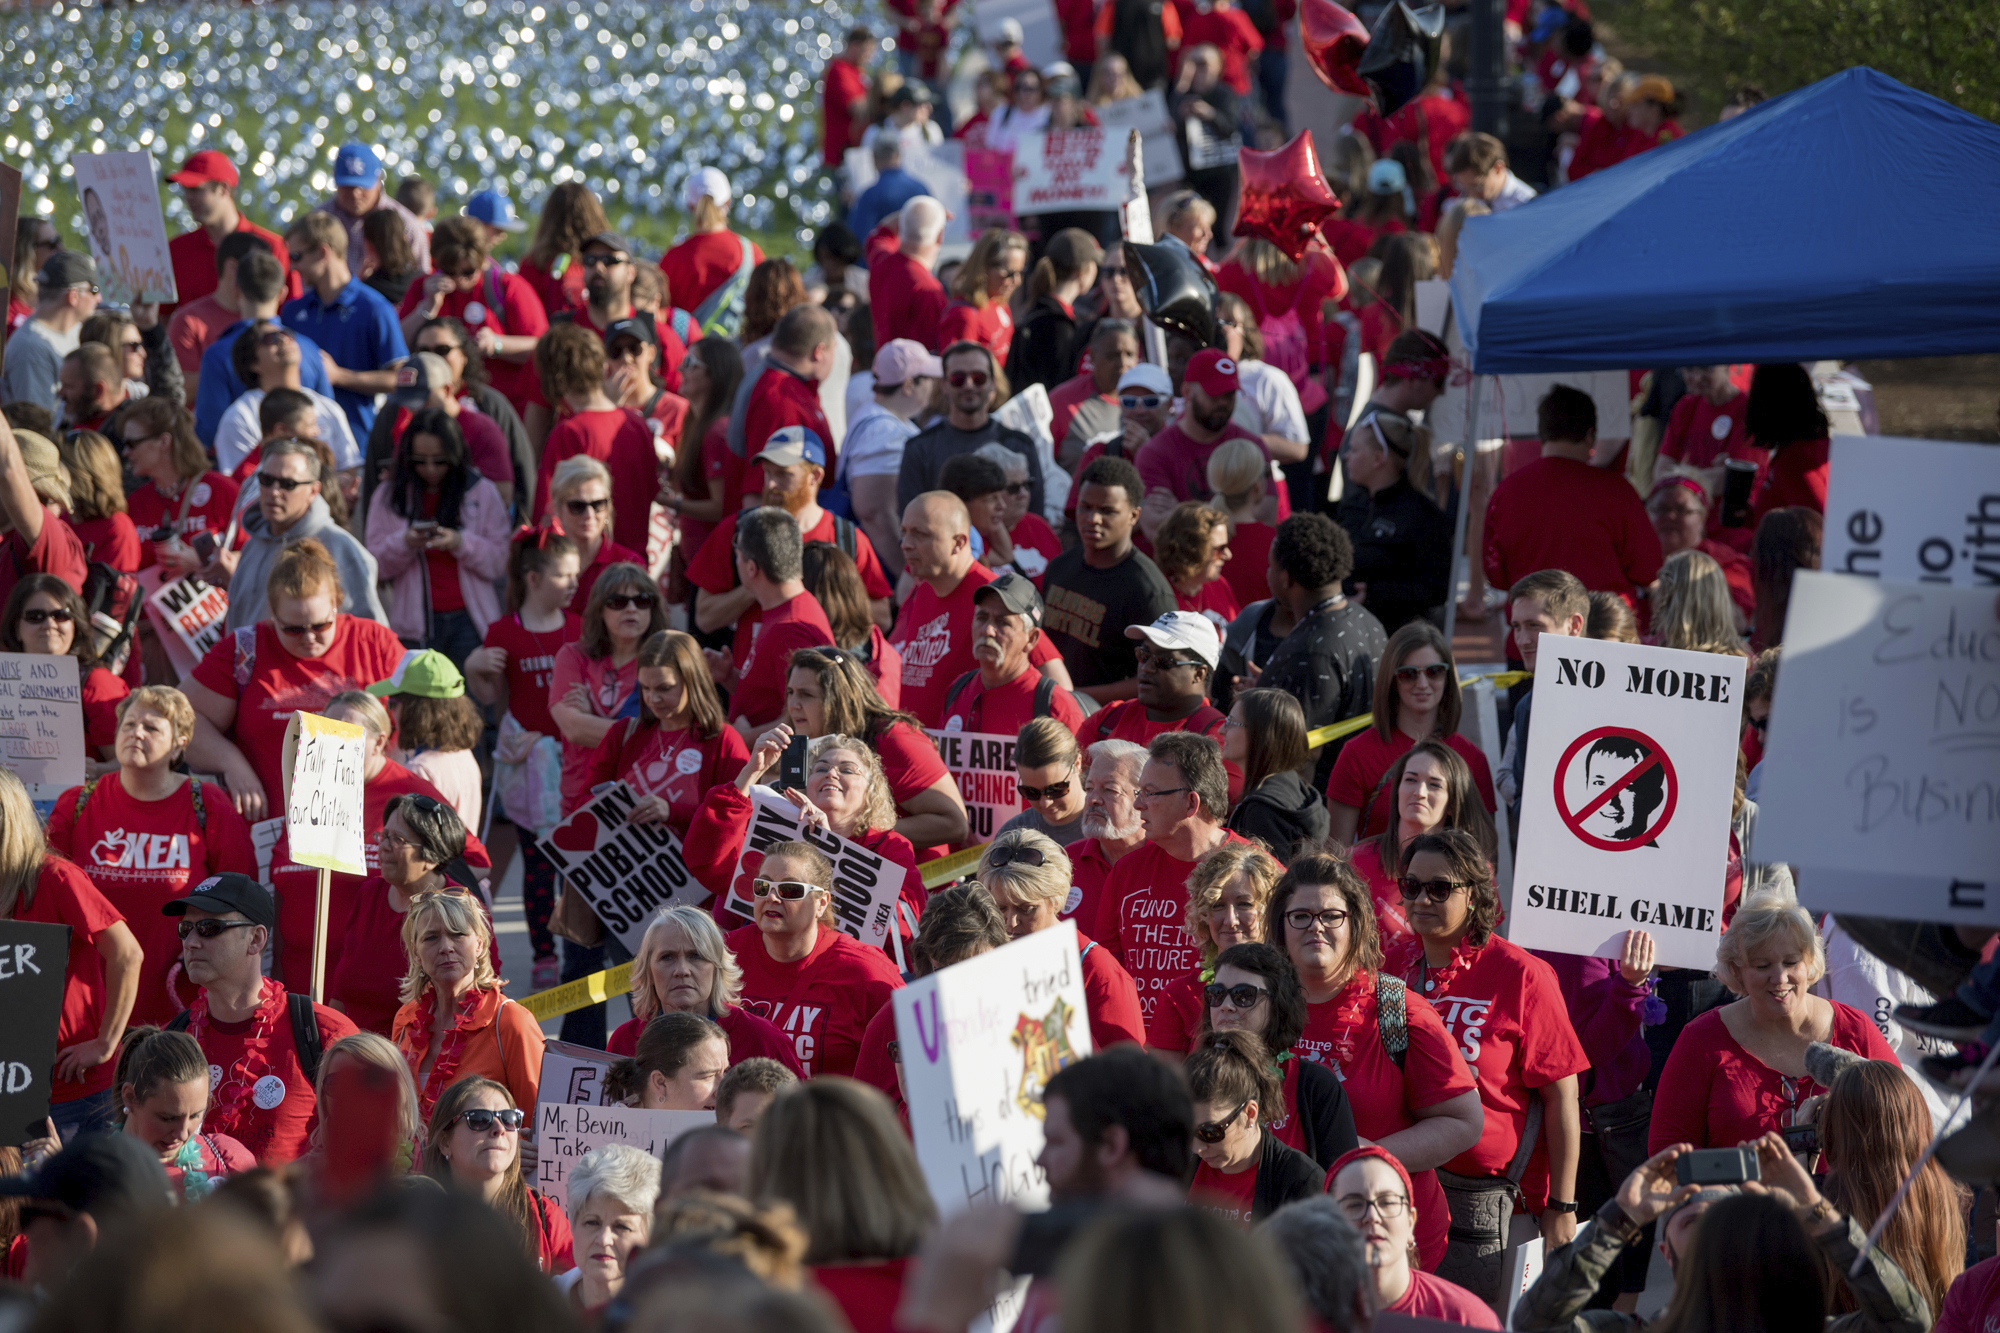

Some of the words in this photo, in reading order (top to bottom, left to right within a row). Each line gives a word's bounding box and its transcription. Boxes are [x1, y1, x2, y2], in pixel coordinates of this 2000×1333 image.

[30, 663, 58, 679] AND
[1555, 657, 1606, 689] NO
[1625, 665, 1732, 704] MORE
[19, 683, 79, 699] GOVERNMENT
[18, 703, 38, 717] from
[41, 703, 60, 718] the
[36, 721, 58, 738] the
[5, 740, 61, 755] EARNED!
[969, 739, 1017, 772] ARE
[303, 736, 326, 786] Fully
[292, 805, 308, 825] our
[590, 784, 637, 832] MY
[120, 832, 191, 869] KEA
[567, 818, 671, 903] PUBLIC
[876, 902, 892, 928] KEA
[1130, 899, 1178, 919] FUND
[1527, 884, 1623, 920] SHELL
[1630, 899, 1716, 932] GAME
[1128, 948, 1193, 970] FUTURE
[1022, 948, 1071, 1005] tried
[543, 1105, 569, 1134] Mr.
[576, 1107, 628, 1139] Bevin,
[549, 1136, 592, 1157] Take
[540, 1159, 567, 1183] It
